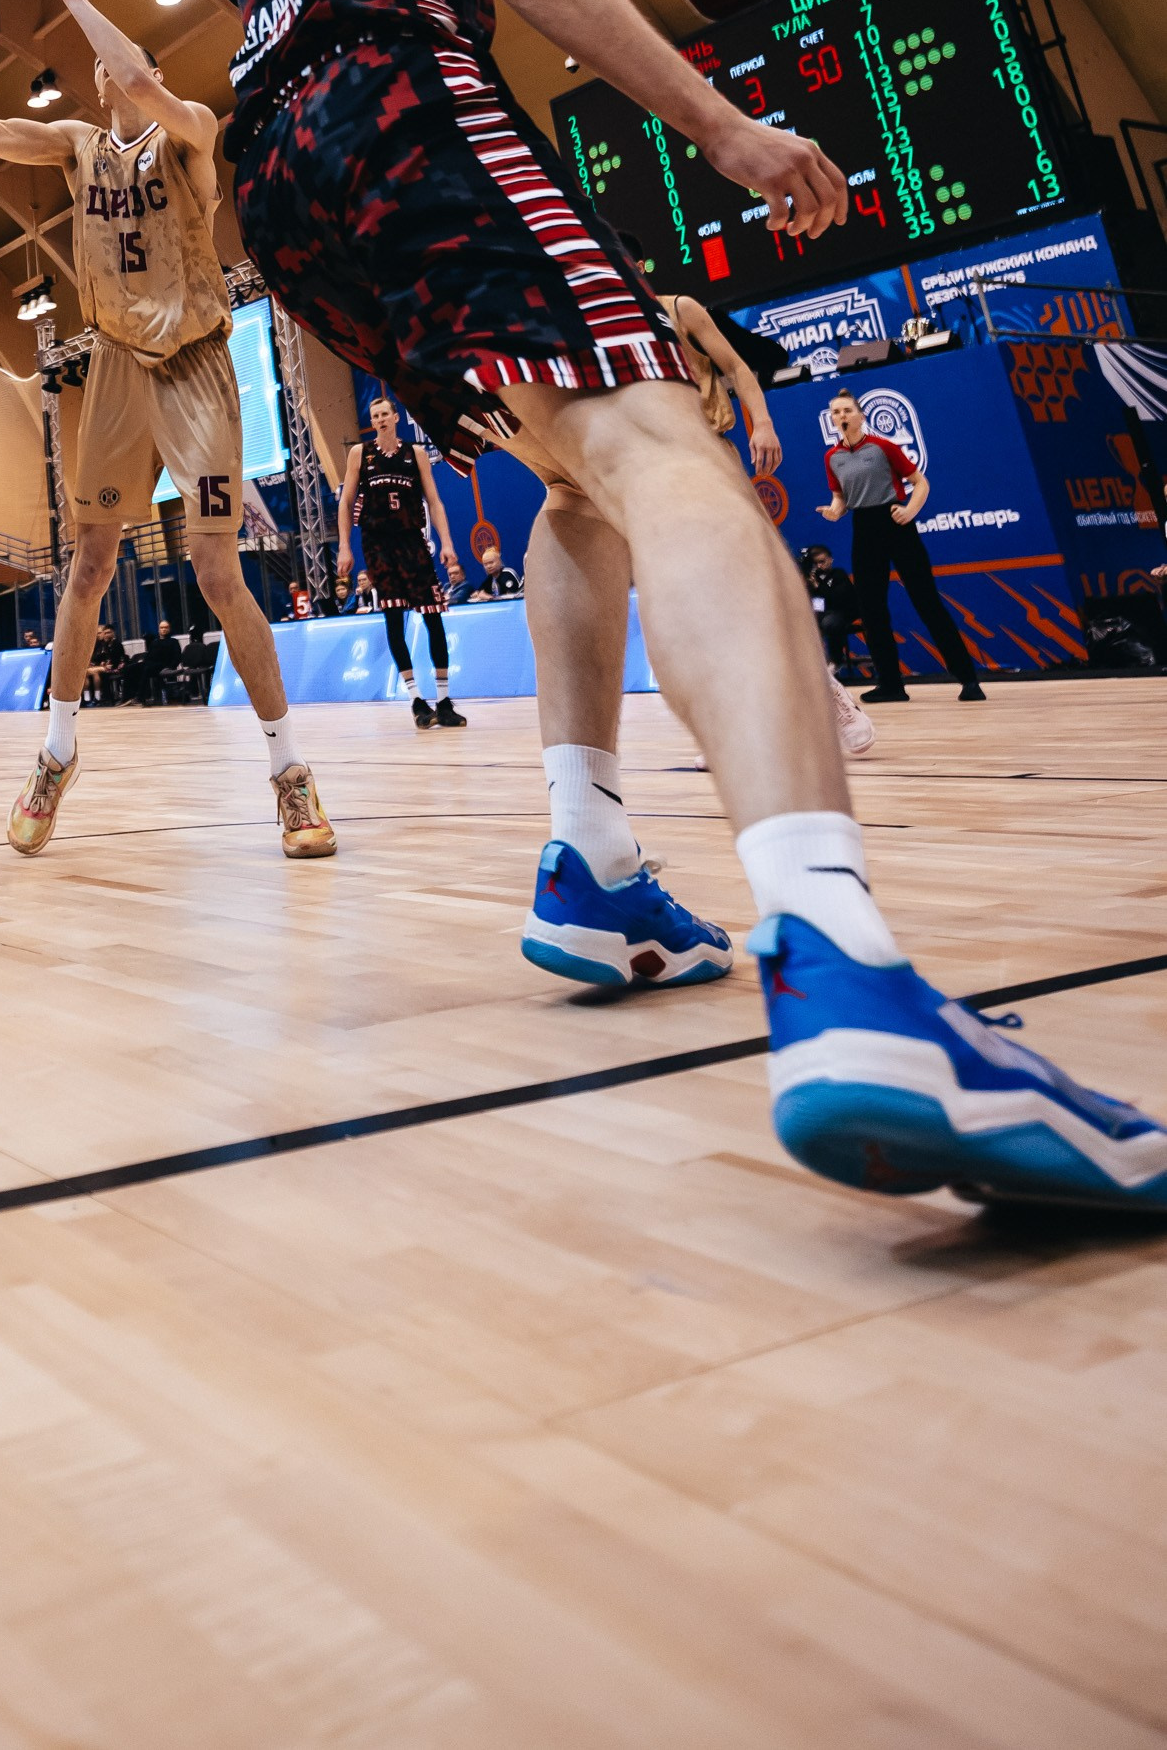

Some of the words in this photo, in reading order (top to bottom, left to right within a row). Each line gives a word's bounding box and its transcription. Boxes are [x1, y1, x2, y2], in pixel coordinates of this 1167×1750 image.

[772, 13, 812, 41] ТУЛА
[859, 3, 872, 26] 7
[799, 29, 825, 48] СЧЕТ
[853, 24, 880, 51] 10
[993, 17, 1010, 41] 0
[859, 45, 884, 71] 11
[999, 37, 1018, 64] 5
[797, 44, 843, 93] 50
[865, 63, 893, 91] 13
[744, 76, 767, 115] 3
[871, 86, 899, 112] 15
[1014, 83, 1031, 107] 0
[877, 104, 902, 132] 17
[1021, 105, 1038, 129] 0
[655, 134, 667, 154] 0
[880, 126, 911, 154] 23
[575, 148, 586, 168] 5
[659, 152, 671, 172] 9
[887, 146, 914, 176] 27
[1036, 149, 1053, 175] 6
[578, 165, 589, 185] 9
[663, 169, 675, 190] 0
[893, 168, 923, 196] 28
[1027, 173, 1061, 203] 13
[86, 178, 168, 222] ЦИВС
[667, 187, 679, 208] 0
[855, 187, 887, 228] 4
[899, 190, 927, 218] 31
[672, 206, 684, 227] 0
[905, 212, 935, 240] 35
[675, 225, 686, 246] 7
[1034, 234, 1098, 263] КОМАНД
[119, 231, 148, 273] 15
[680, 243, 693, 265] 2
[777, 322, 834, 351] ИНАЛ
[197, 475, 232, 518] 15
[388, 491, 411, 511] 5
[1065, 477, 1134, 512] ЦЕЛЬ
[296, 595, 310, 616] 5
